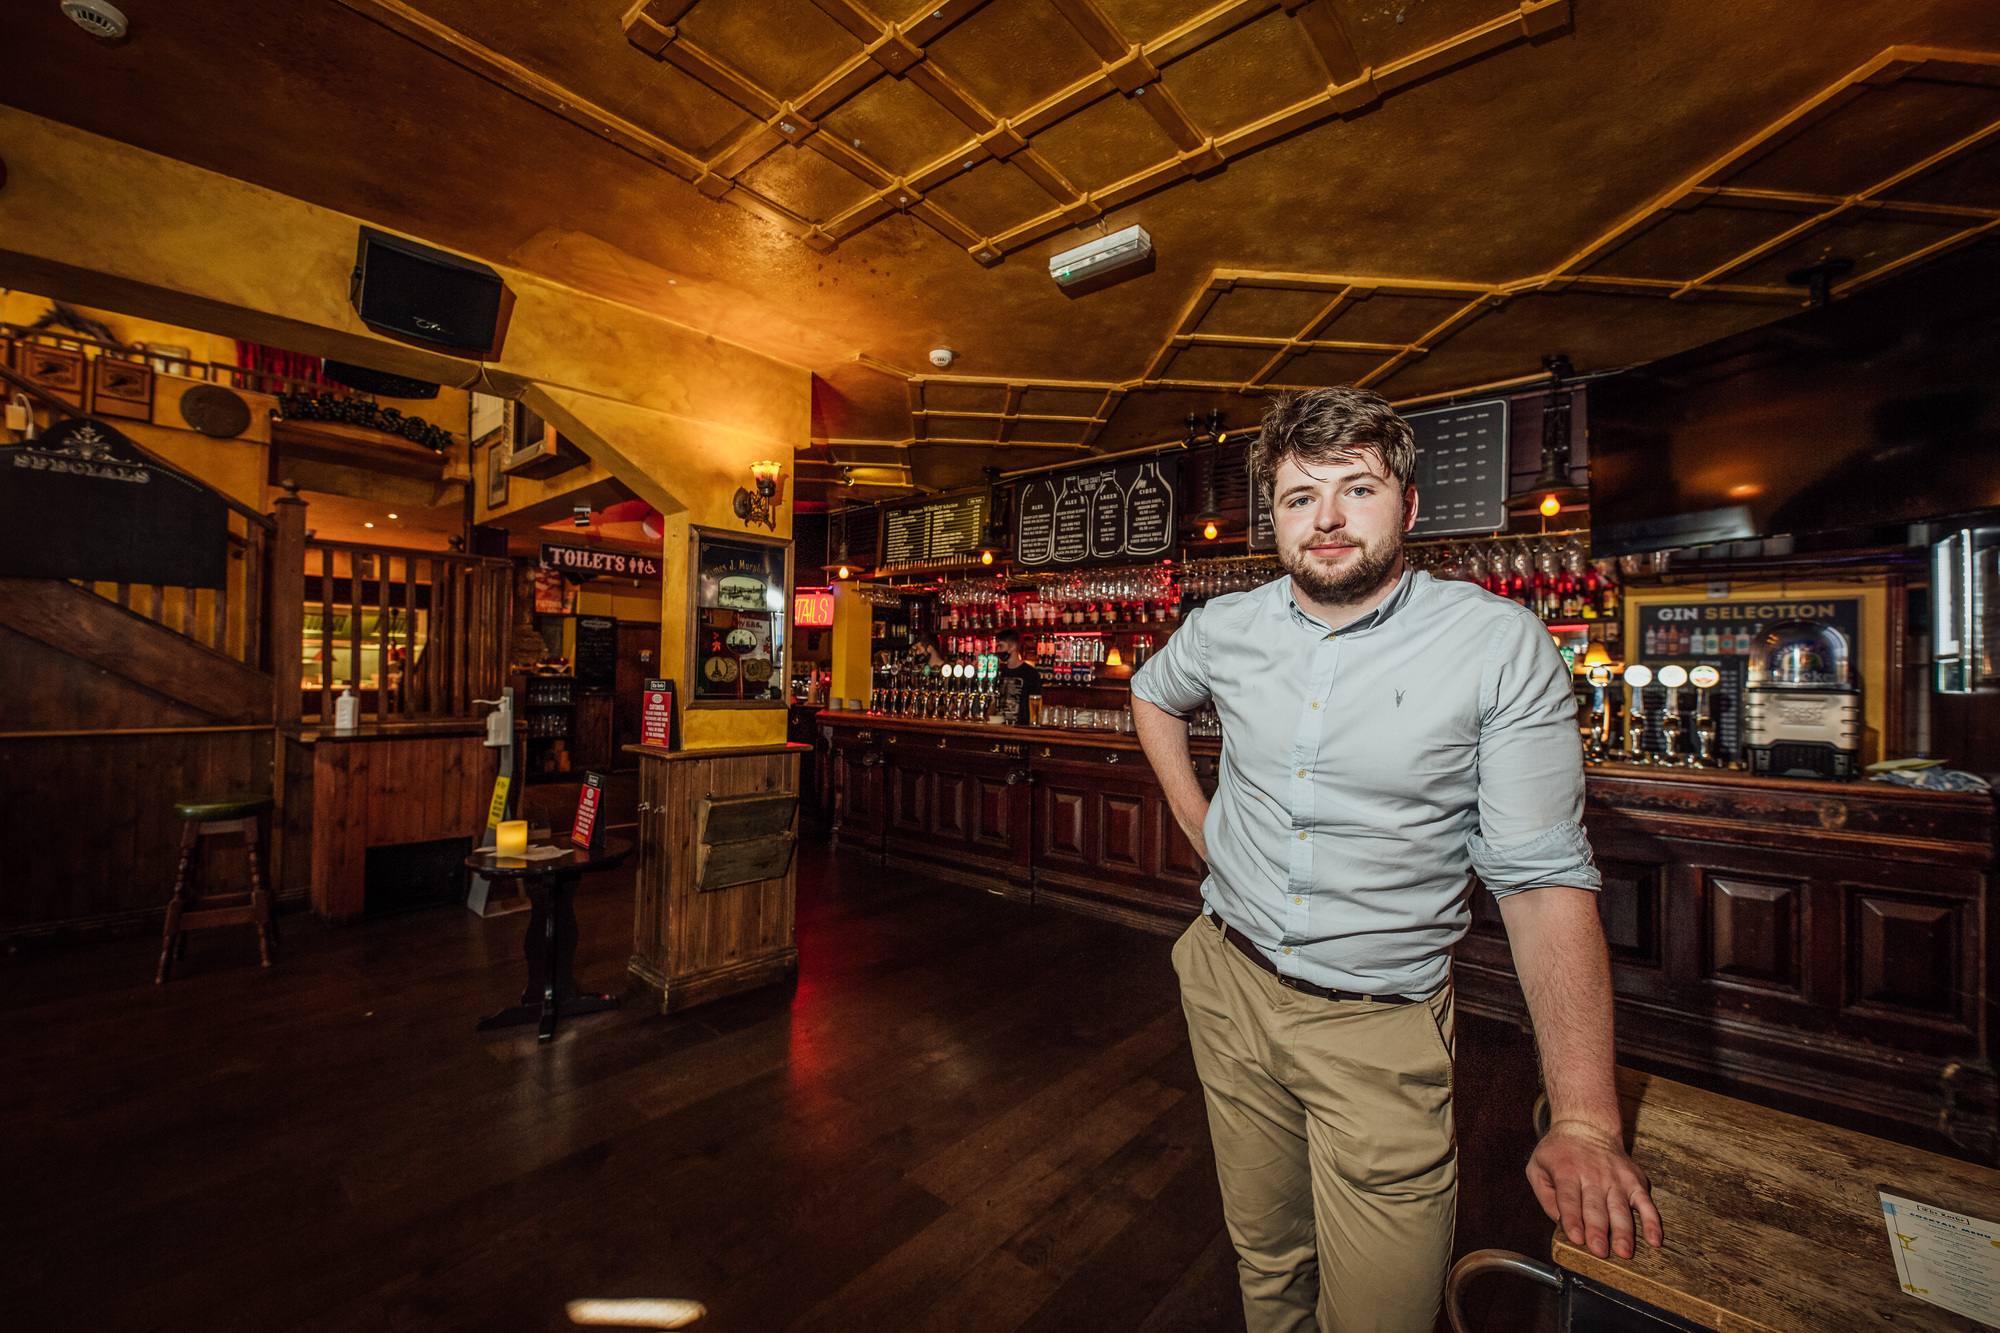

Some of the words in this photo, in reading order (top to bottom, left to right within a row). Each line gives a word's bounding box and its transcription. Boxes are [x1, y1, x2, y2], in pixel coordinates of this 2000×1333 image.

[13, 454, 150, 484] SPECIALS
[548, 546, 625, 572] TOILETS
[729, 560, 736, 571] J.
[796, 598, 828, 624] TAILS
[1658, 607, 1698, 621] GIN
[1704, 604, 1836, 620] SELECTION
